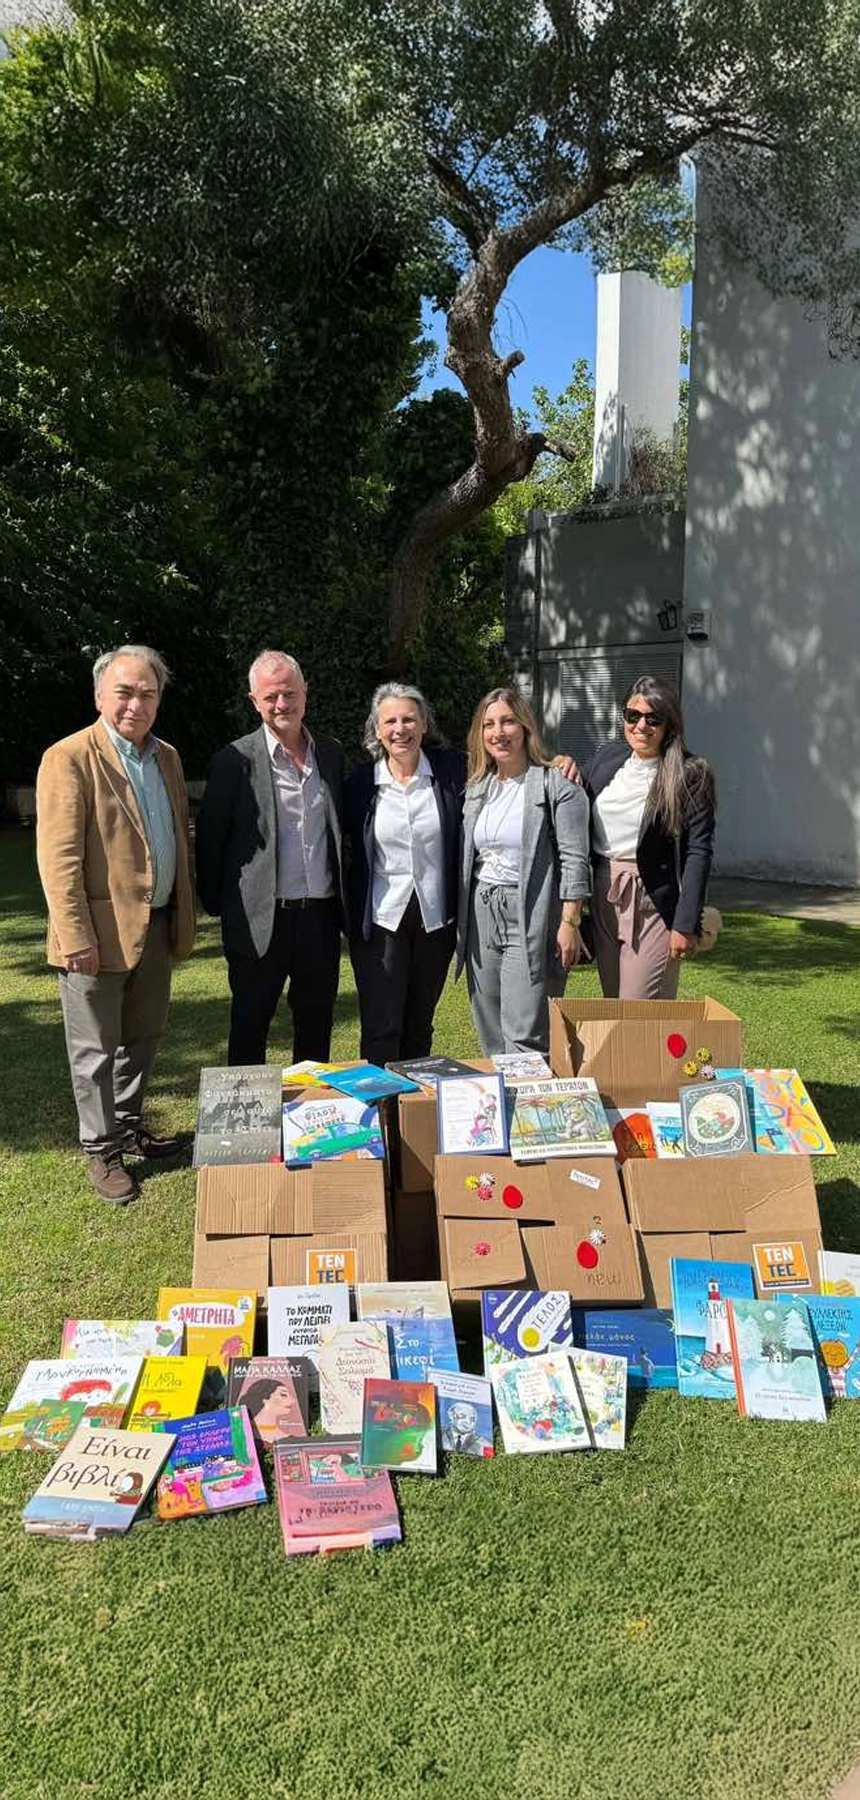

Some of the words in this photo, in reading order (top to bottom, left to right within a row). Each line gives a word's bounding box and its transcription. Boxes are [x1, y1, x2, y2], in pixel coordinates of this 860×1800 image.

[316, 1254, 346, 1268] TEN
[764, 1246, 795, 1263] TEN
[178, 1306, 236, 1326] ΑΜΕΤΡΗΤΑ
[286, 1306, 296, 1316] ΤΟ
[297, 1304, 333, 1316] ΚΟΜΜΑΤΙ
[303, 1315, 332, 1327] ΛΕΙΠΕΙ
[82, 1435, 151, 1461] Είναι
